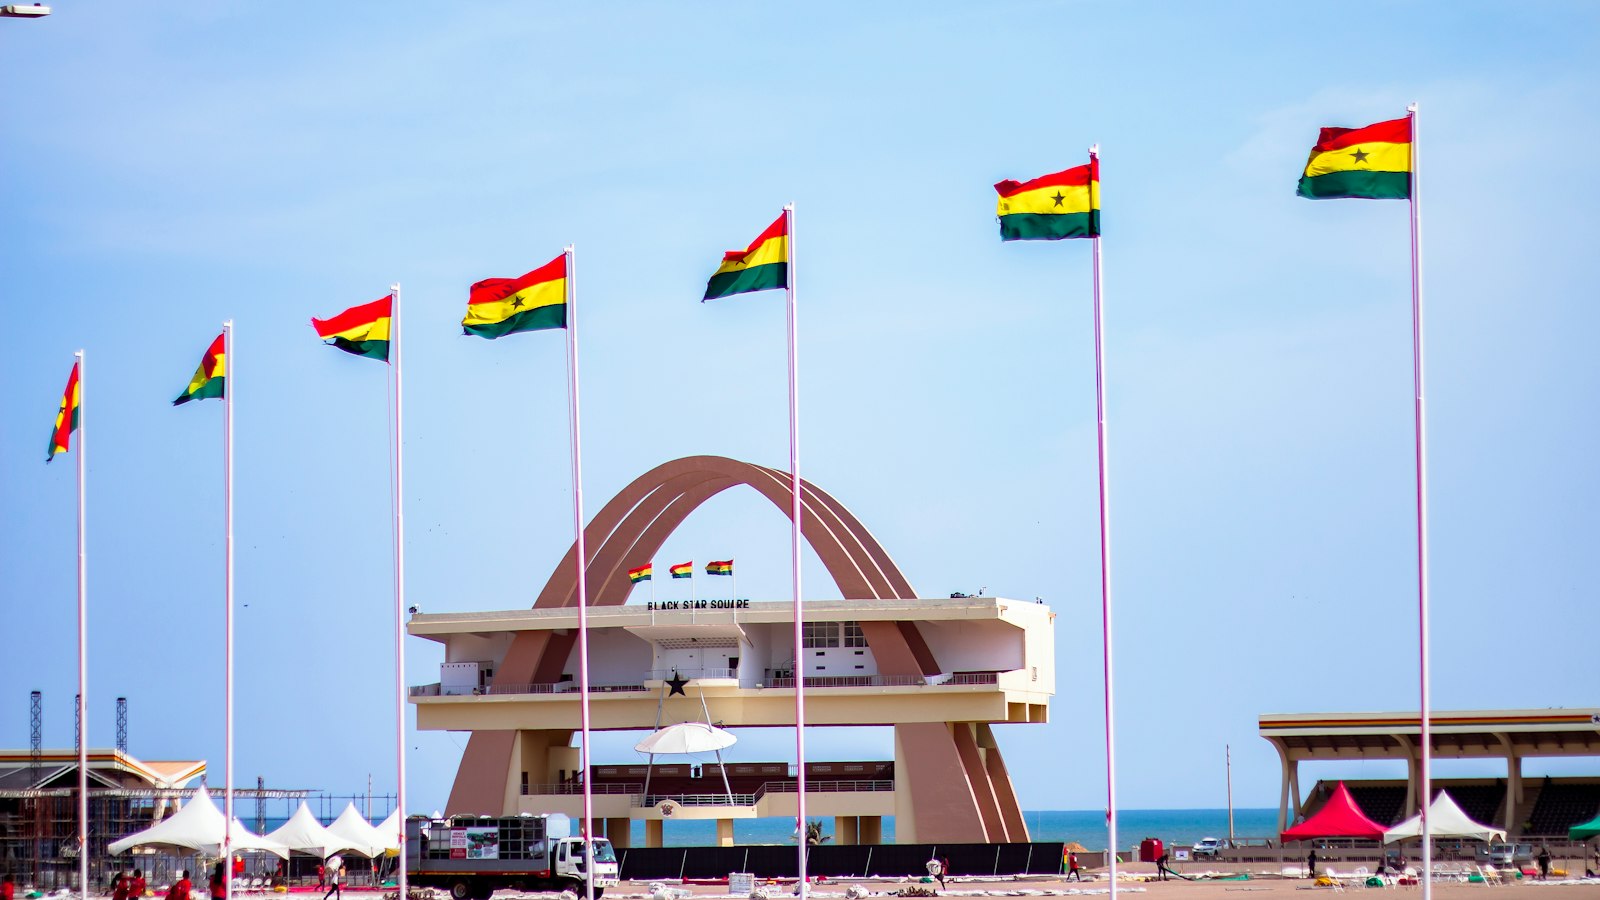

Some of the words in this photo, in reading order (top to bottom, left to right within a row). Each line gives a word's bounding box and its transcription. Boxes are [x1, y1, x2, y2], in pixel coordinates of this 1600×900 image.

[647, 600, 679, 611] BLACK
[682, 599, 707, 610] STAR
[710, 599, 750, 609] SQUARE
